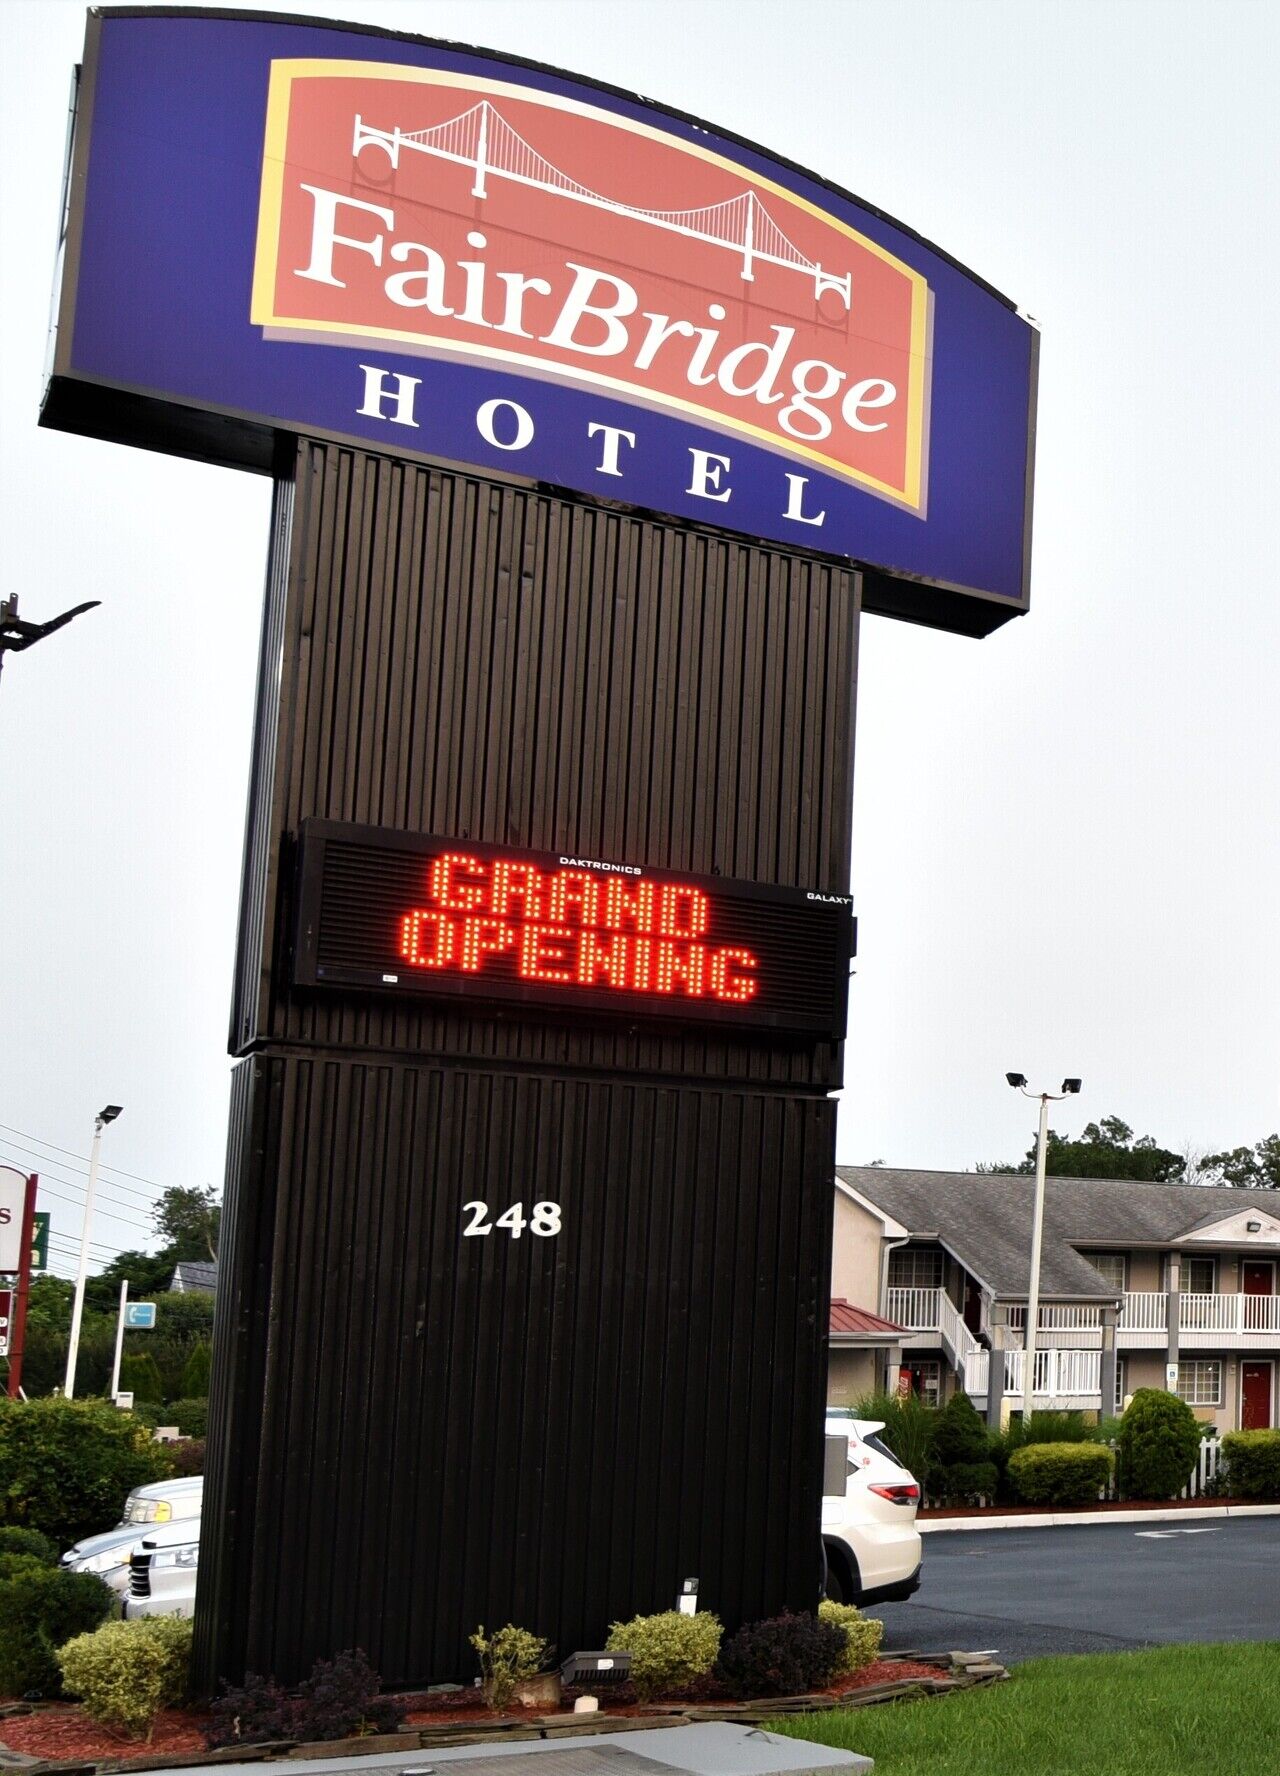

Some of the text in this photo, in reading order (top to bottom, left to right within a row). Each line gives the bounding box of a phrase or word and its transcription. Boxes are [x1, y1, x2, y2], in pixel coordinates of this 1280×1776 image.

[293, 182, 897, 441] FairBridge
[356, 364, 826, 527] HOTEL
[431, 853, 708, 938] GRAND
[559, 855, 642, 876] DAKTRONICS
[806, 891, 850, 906] GALAXY
[400, 910, 758, 1001] OPENING
[462, 1200, 562, 1239] 248
